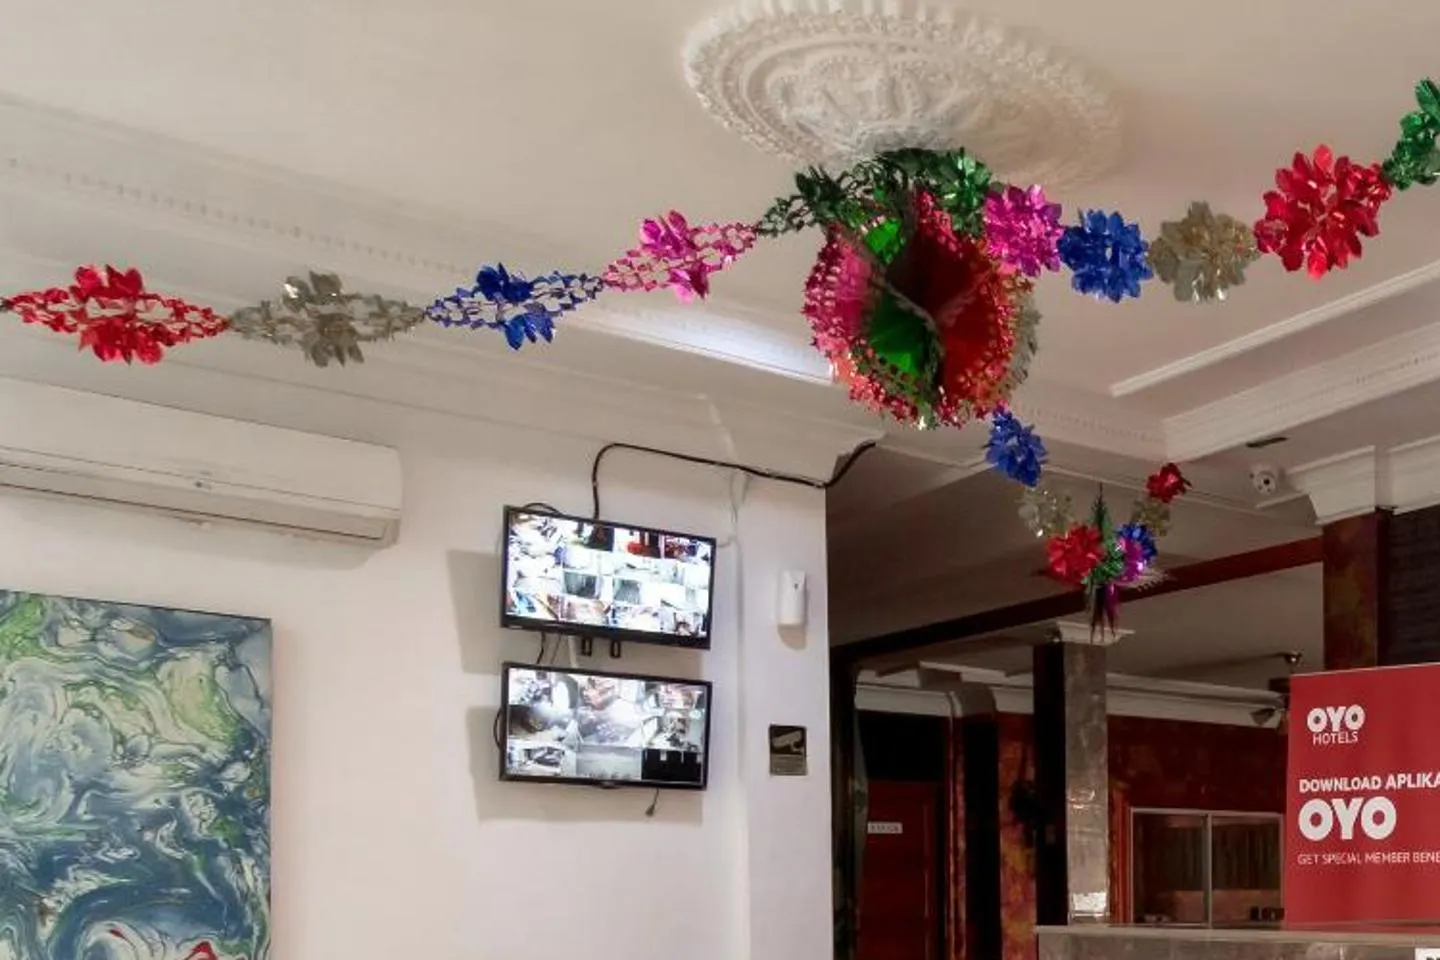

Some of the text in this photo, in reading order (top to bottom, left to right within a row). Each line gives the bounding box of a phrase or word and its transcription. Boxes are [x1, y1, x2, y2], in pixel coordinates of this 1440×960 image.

[1306, 704, 1365, 733] OYO
[1312, 731, 1359, 746] HOTELS
[1299, 776, 1381, 792] DOWNLOAD
[1298, 796, 1397, 841] OYO
[1297, 853, 1319, 866] GET
[1321, 852, 1362, 865] SPECIAL
[1364, 851, 1410, 864] MEMBER
